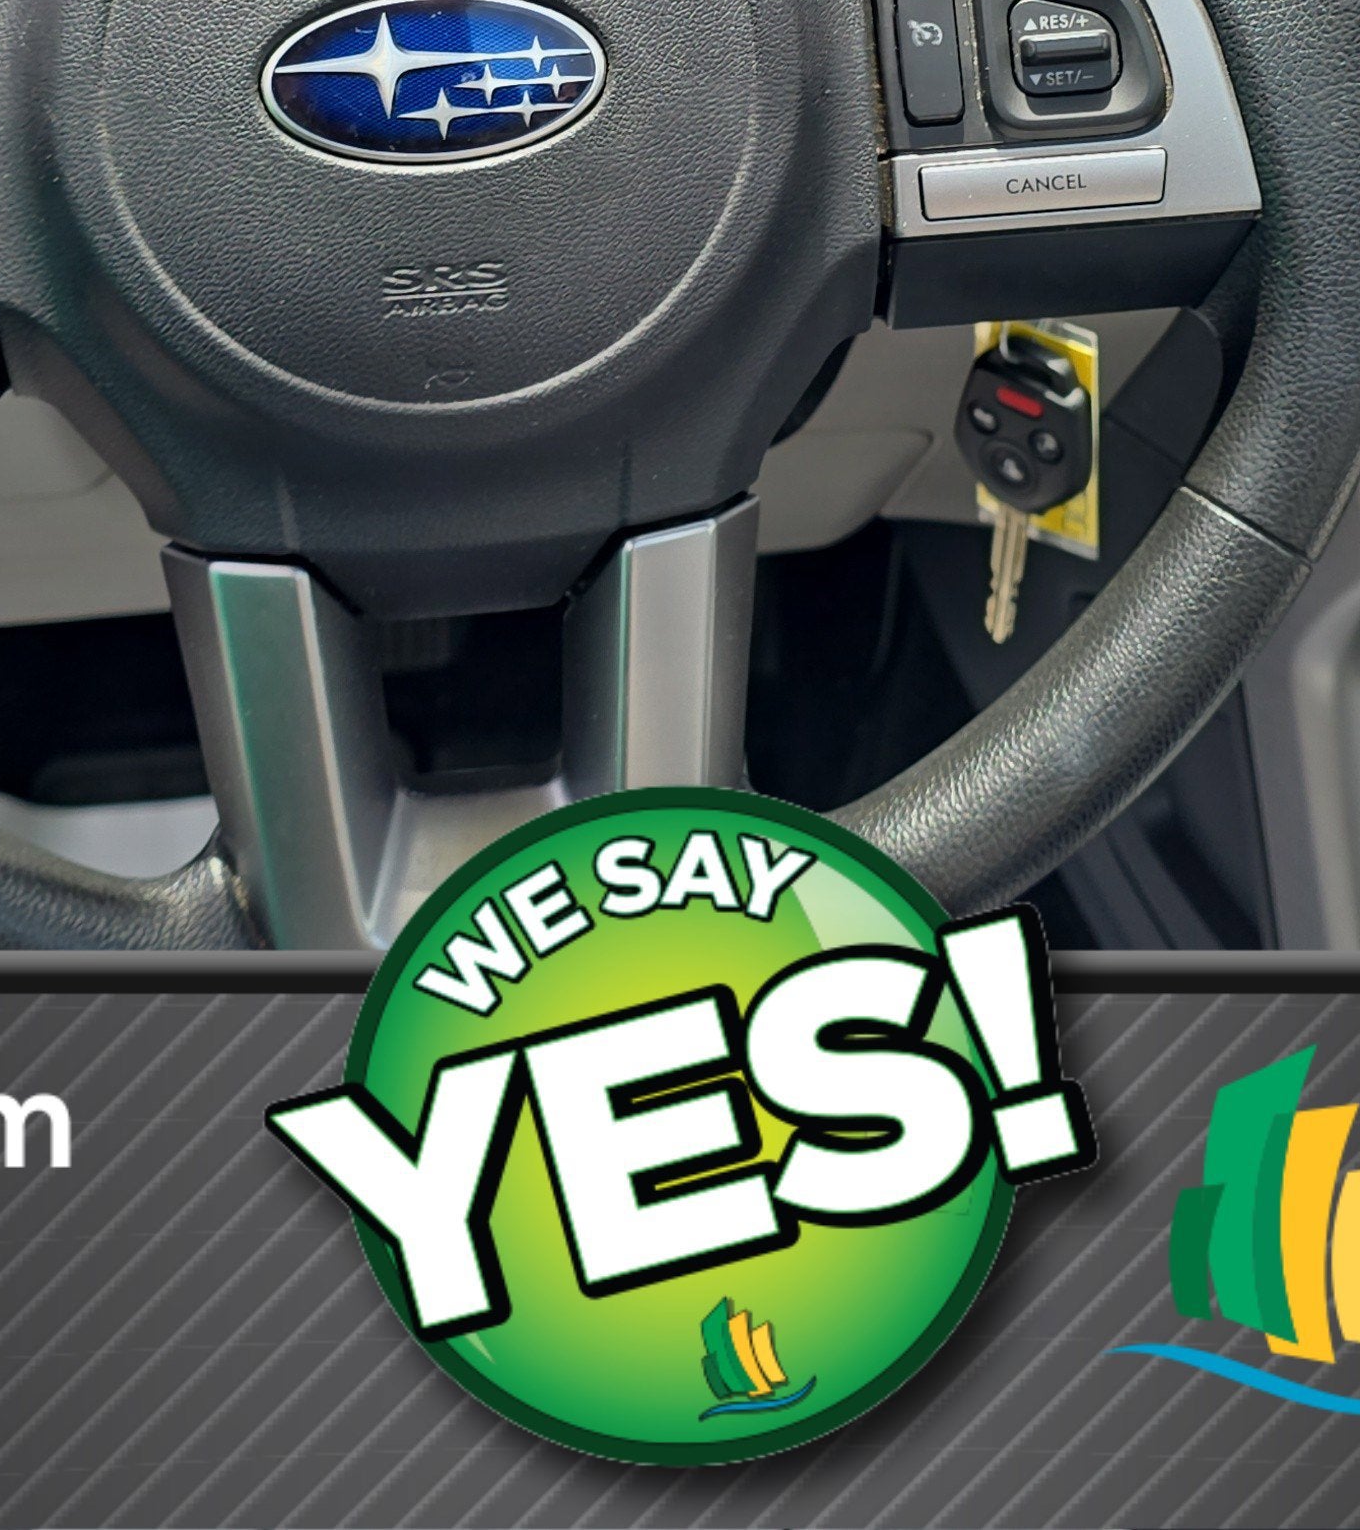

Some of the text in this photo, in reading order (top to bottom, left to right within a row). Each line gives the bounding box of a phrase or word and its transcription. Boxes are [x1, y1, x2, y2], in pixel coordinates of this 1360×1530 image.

[1039, 14, 1089, 31] RES/+
[1006, 174, 1087, 195] CANCEL
[383, 263, 508, 294] SRS
[384, 294, 509, 319] AIRBAG
